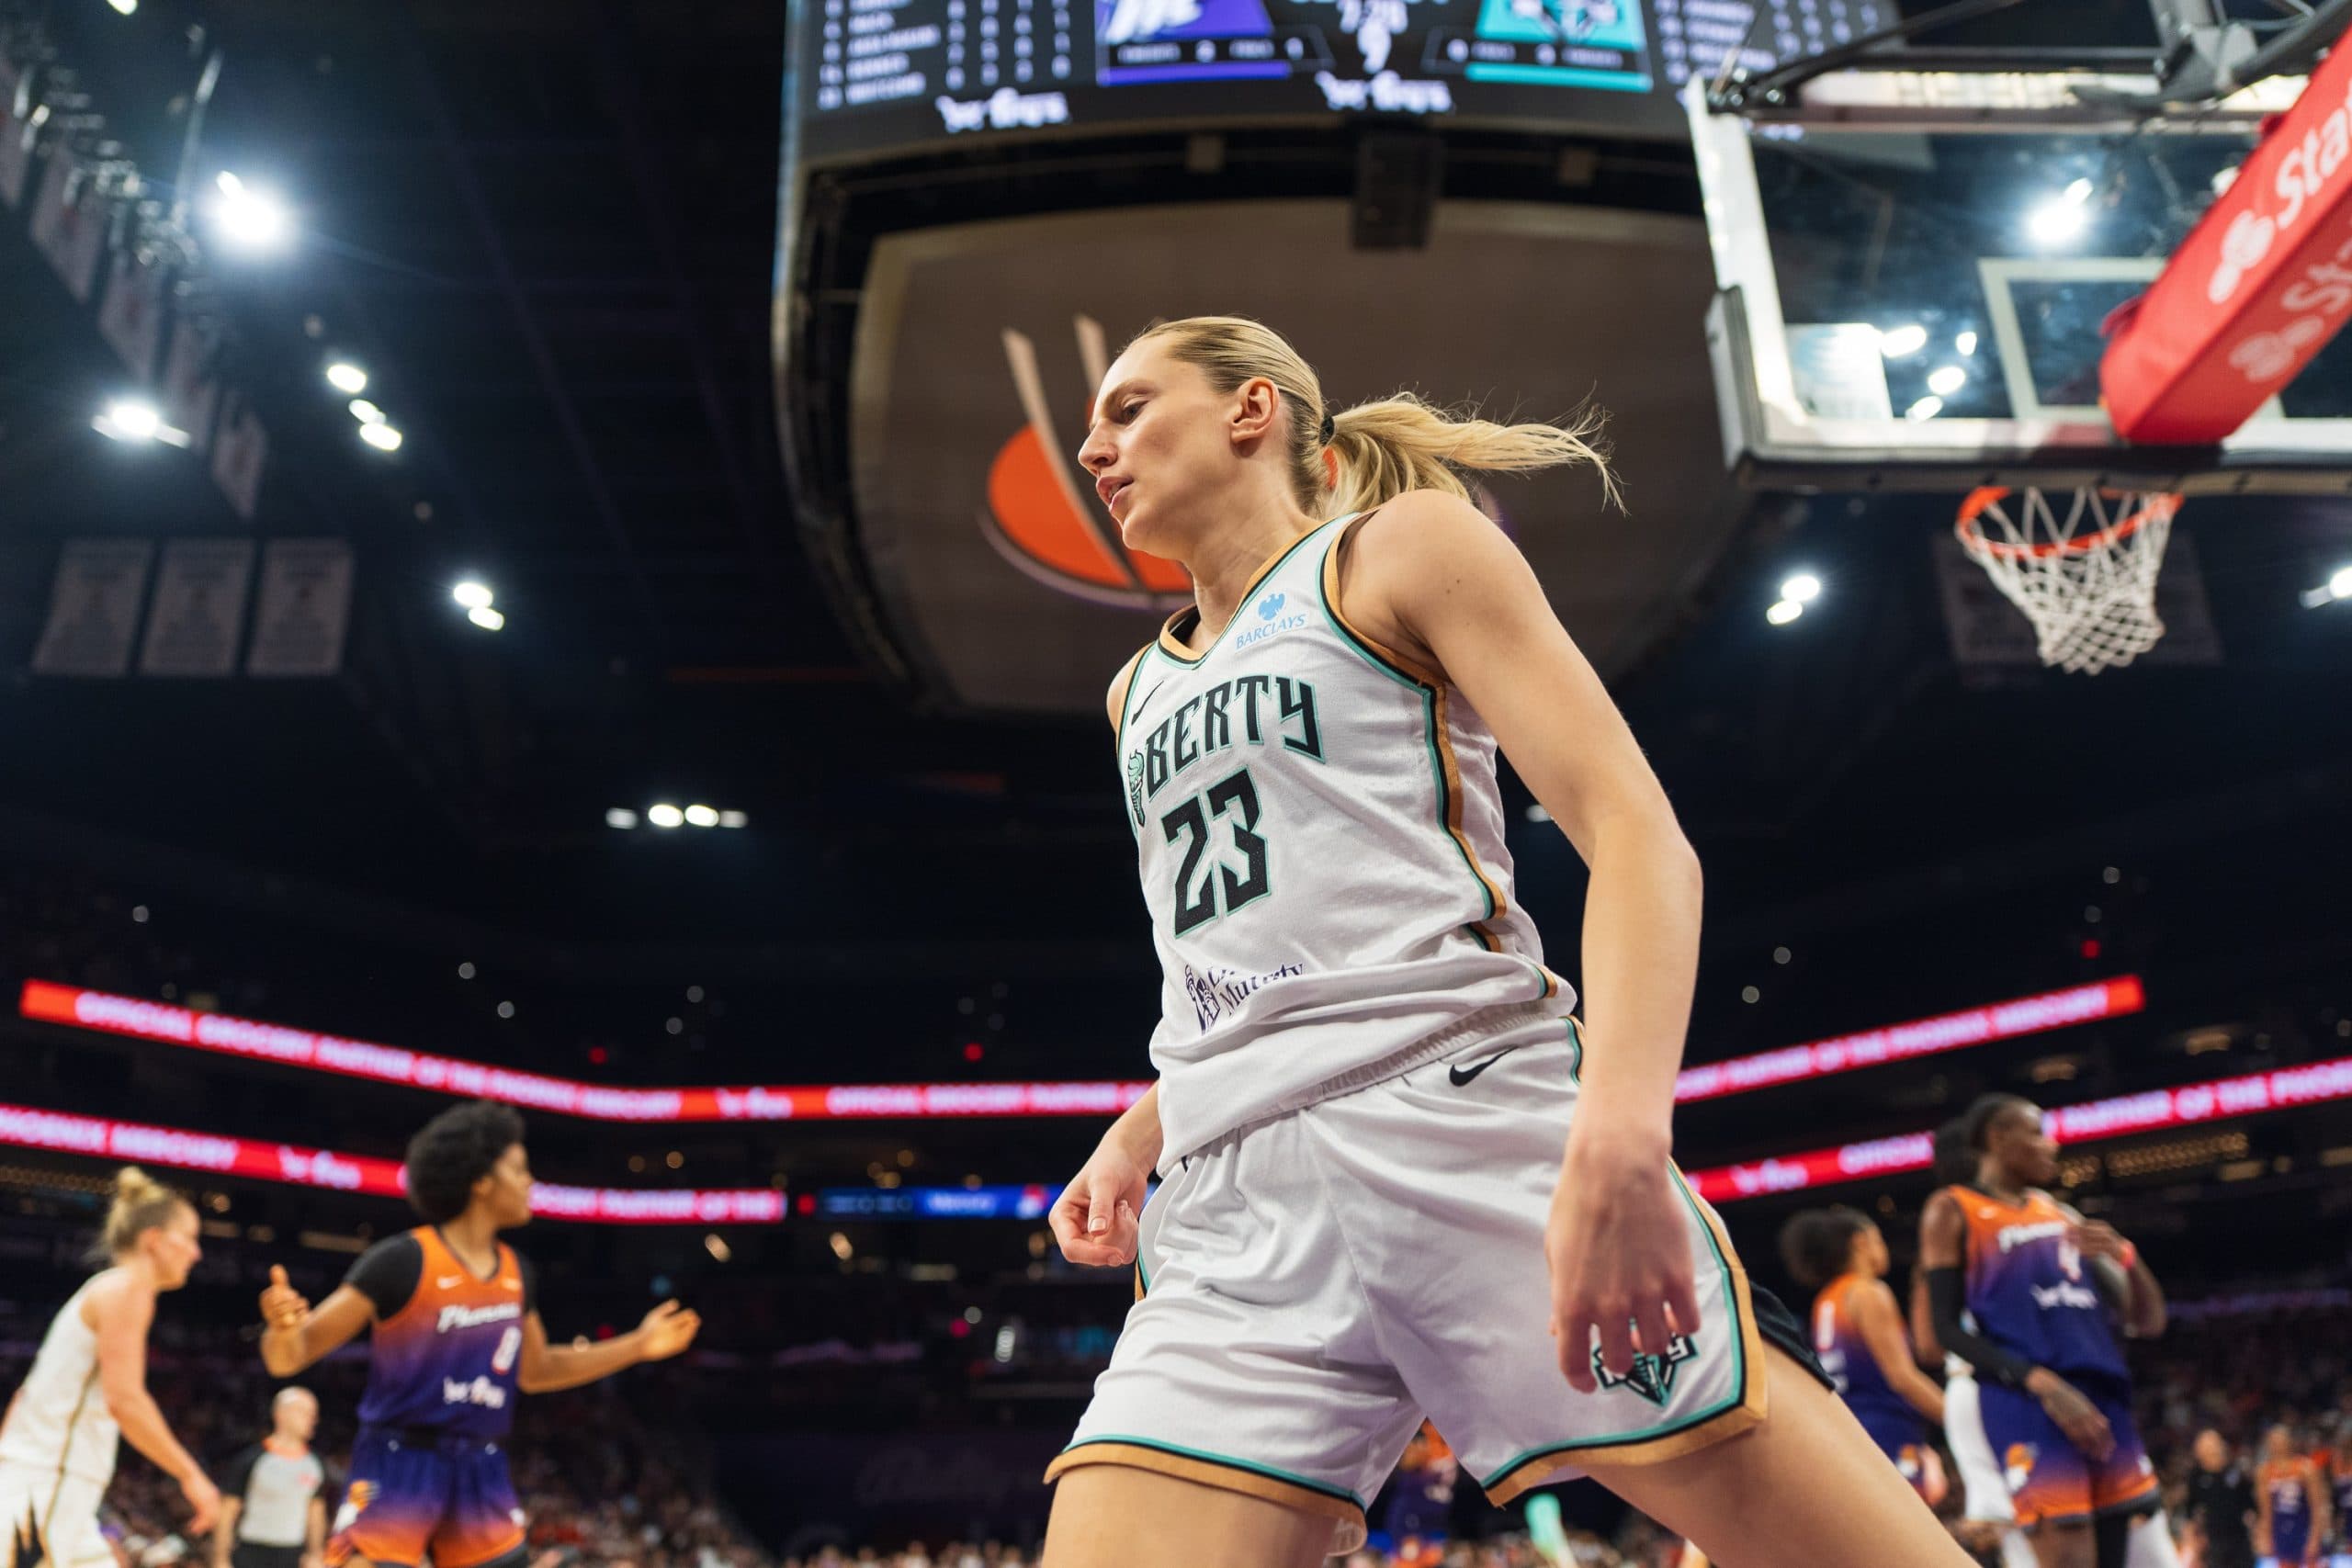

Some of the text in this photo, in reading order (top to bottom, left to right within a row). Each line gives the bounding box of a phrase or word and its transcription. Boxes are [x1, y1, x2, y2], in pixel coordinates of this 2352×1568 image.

[2276, 79, 2352, 229] Sta
[1236, 614, 1306, 649] BARCLAYS
[1128, 674, 1326, 827] BERTY
[1160, 764, 1272, 940] 23
